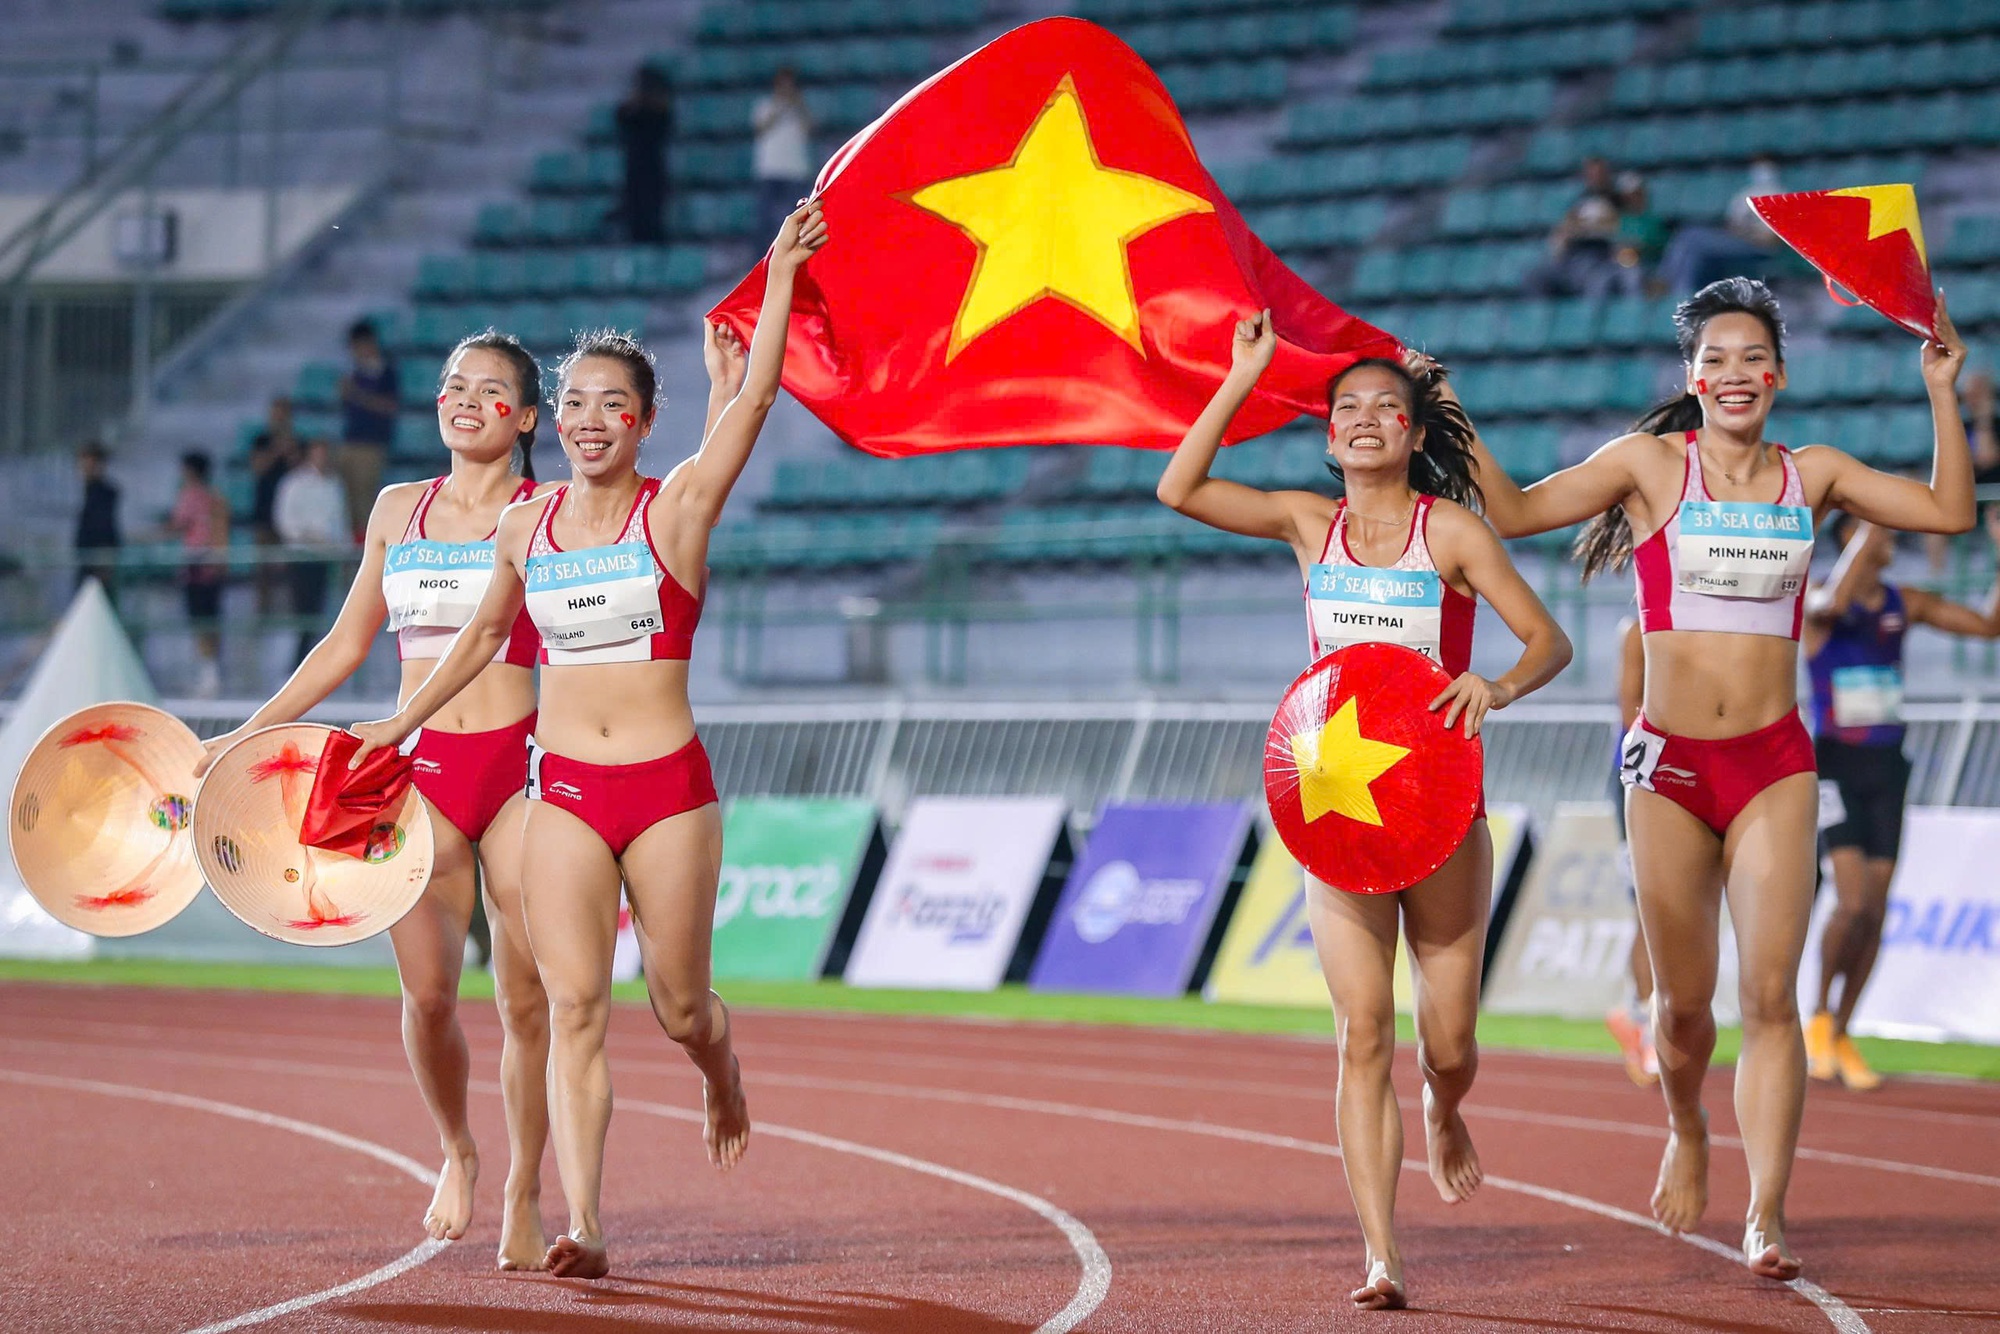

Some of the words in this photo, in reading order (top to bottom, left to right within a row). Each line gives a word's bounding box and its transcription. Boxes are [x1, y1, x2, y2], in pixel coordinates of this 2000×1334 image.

[1722, 512, 1749, 529] SEA
[1753, 513, 1800, 532] GAMES
[417, 548, 443, 565] SEA
[448, 549, 496, 565] GAMES
[1709, 547, 1746, 560] MINH
[1749, 549, 1789, 562] HANH
[554, 562, 583, 581] SEA
[585, 552, 639, 576] GAMES
[419, 579, 459, 590] NGOC
[1344, 576, 1370, 594] SEA
[1371, 579, 1425, 599] GAMES
[1699, 577, 1739, 587] THAILAND
[567, 594, 607, 610] HANG
[631, 617, 654, 630] 649
[1333, 612, 1374, 626] TUYET
[1378, 616, 1403, 629] MAI
